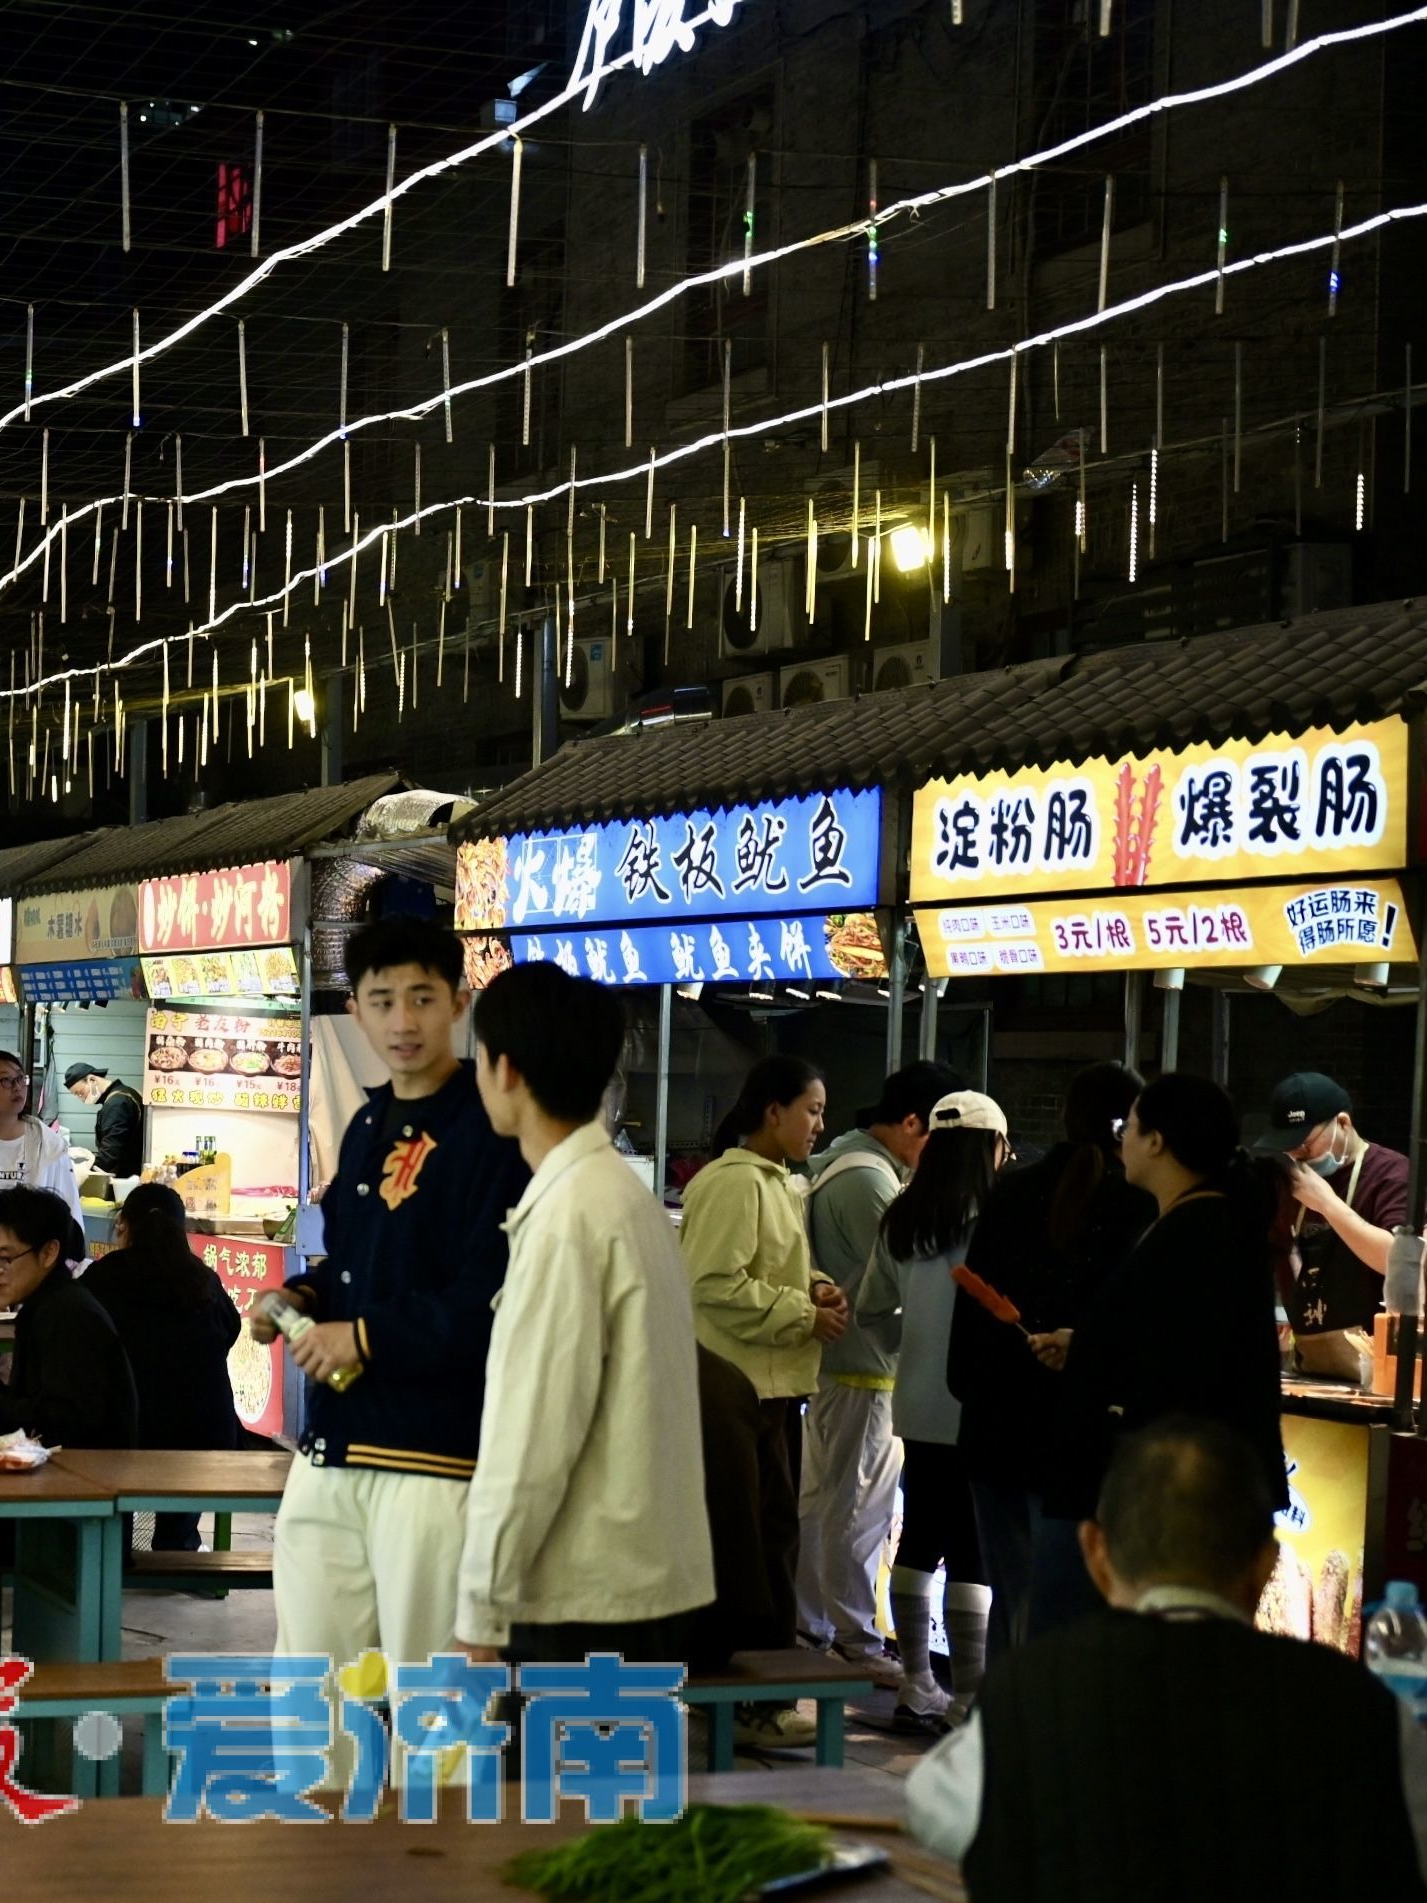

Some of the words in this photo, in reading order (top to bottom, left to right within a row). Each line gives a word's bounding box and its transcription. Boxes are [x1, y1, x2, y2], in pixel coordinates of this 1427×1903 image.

[936, 788, 1092, 871] 淀粉肠
[1180, 753, 1377, 849] 爆裂肠
[513, 832, 602, 924] 火爆
[616, 796, 851, 904] 铁板鱿鱼
[1055, 918, 1130, 950] 3元/根
[1148, 911, 1248, 945] 5元/2根
[1287, 890, 1376, 927] 好运肠来
[670, 919, 812, 980] 鱿鱼夹饼
[203, 1243, 268, 1280] 锅气浓郁
